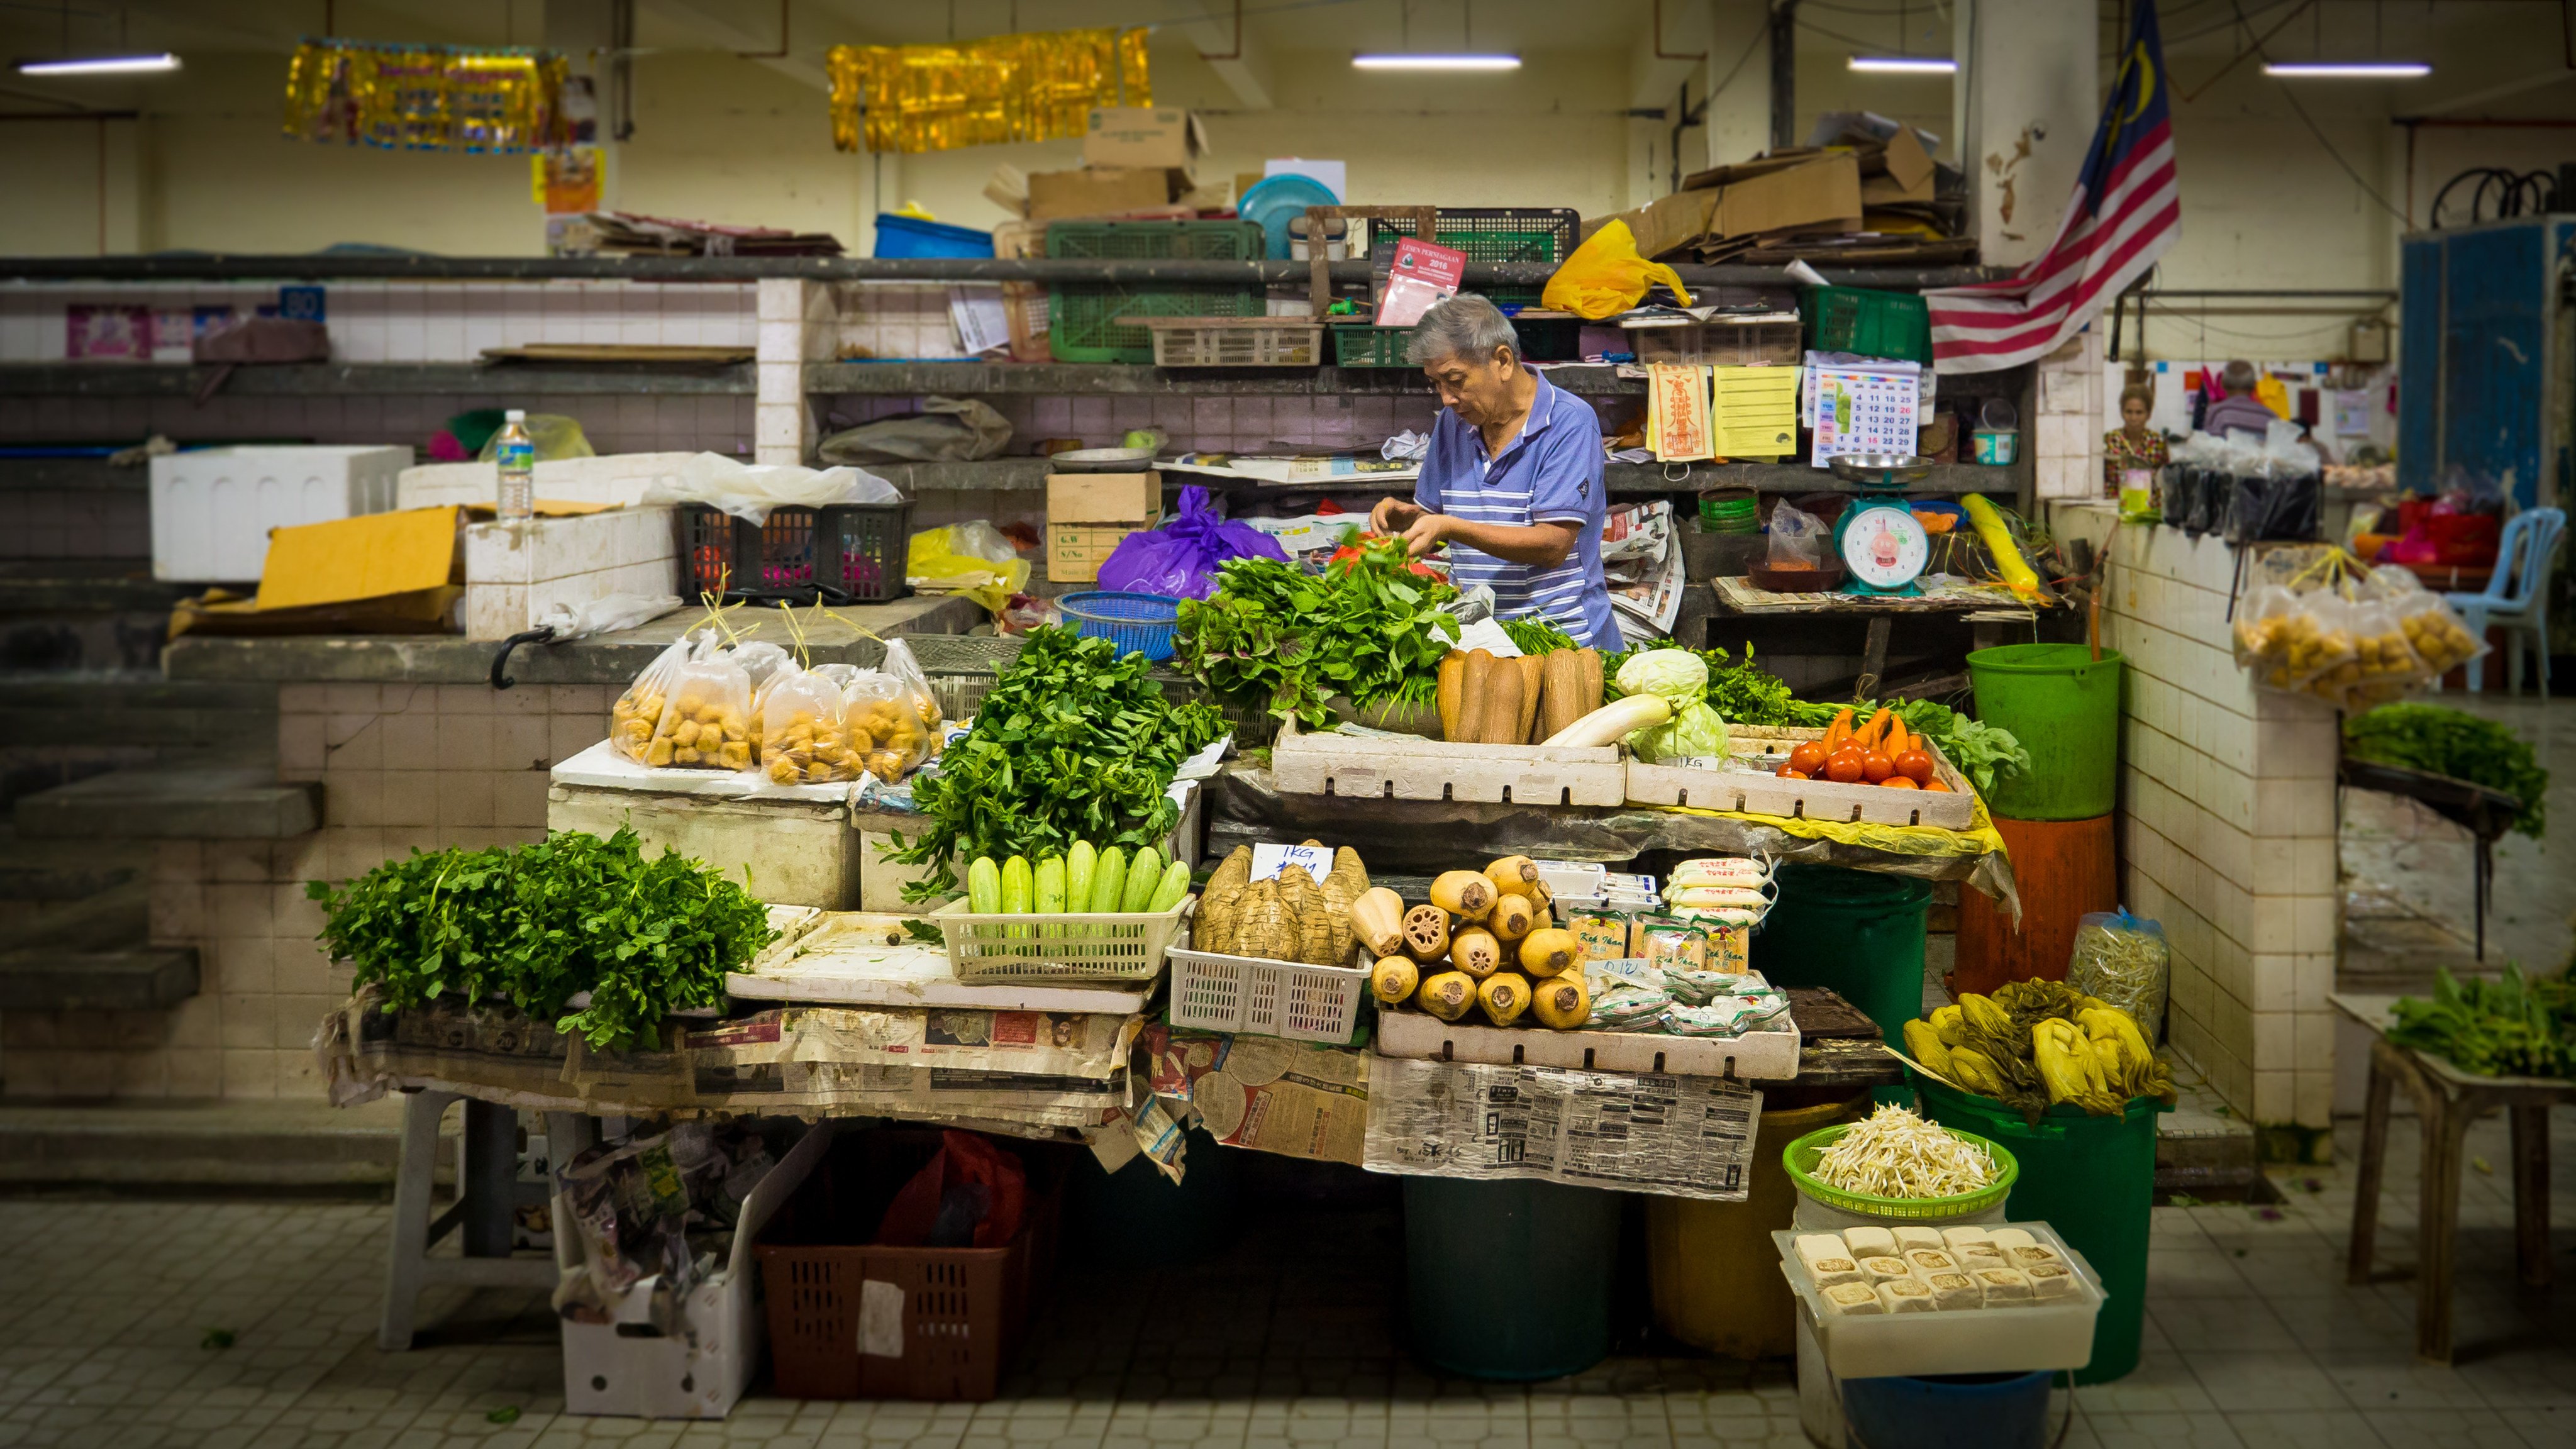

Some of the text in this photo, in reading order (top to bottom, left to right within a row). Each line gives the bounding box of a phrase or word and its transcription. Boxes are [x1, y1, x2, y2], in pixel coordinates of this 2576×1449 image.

[1402, 243, 1460, 263] LESEN PERNIAGAAN
[1429, 259, 1448, 270] 2016
